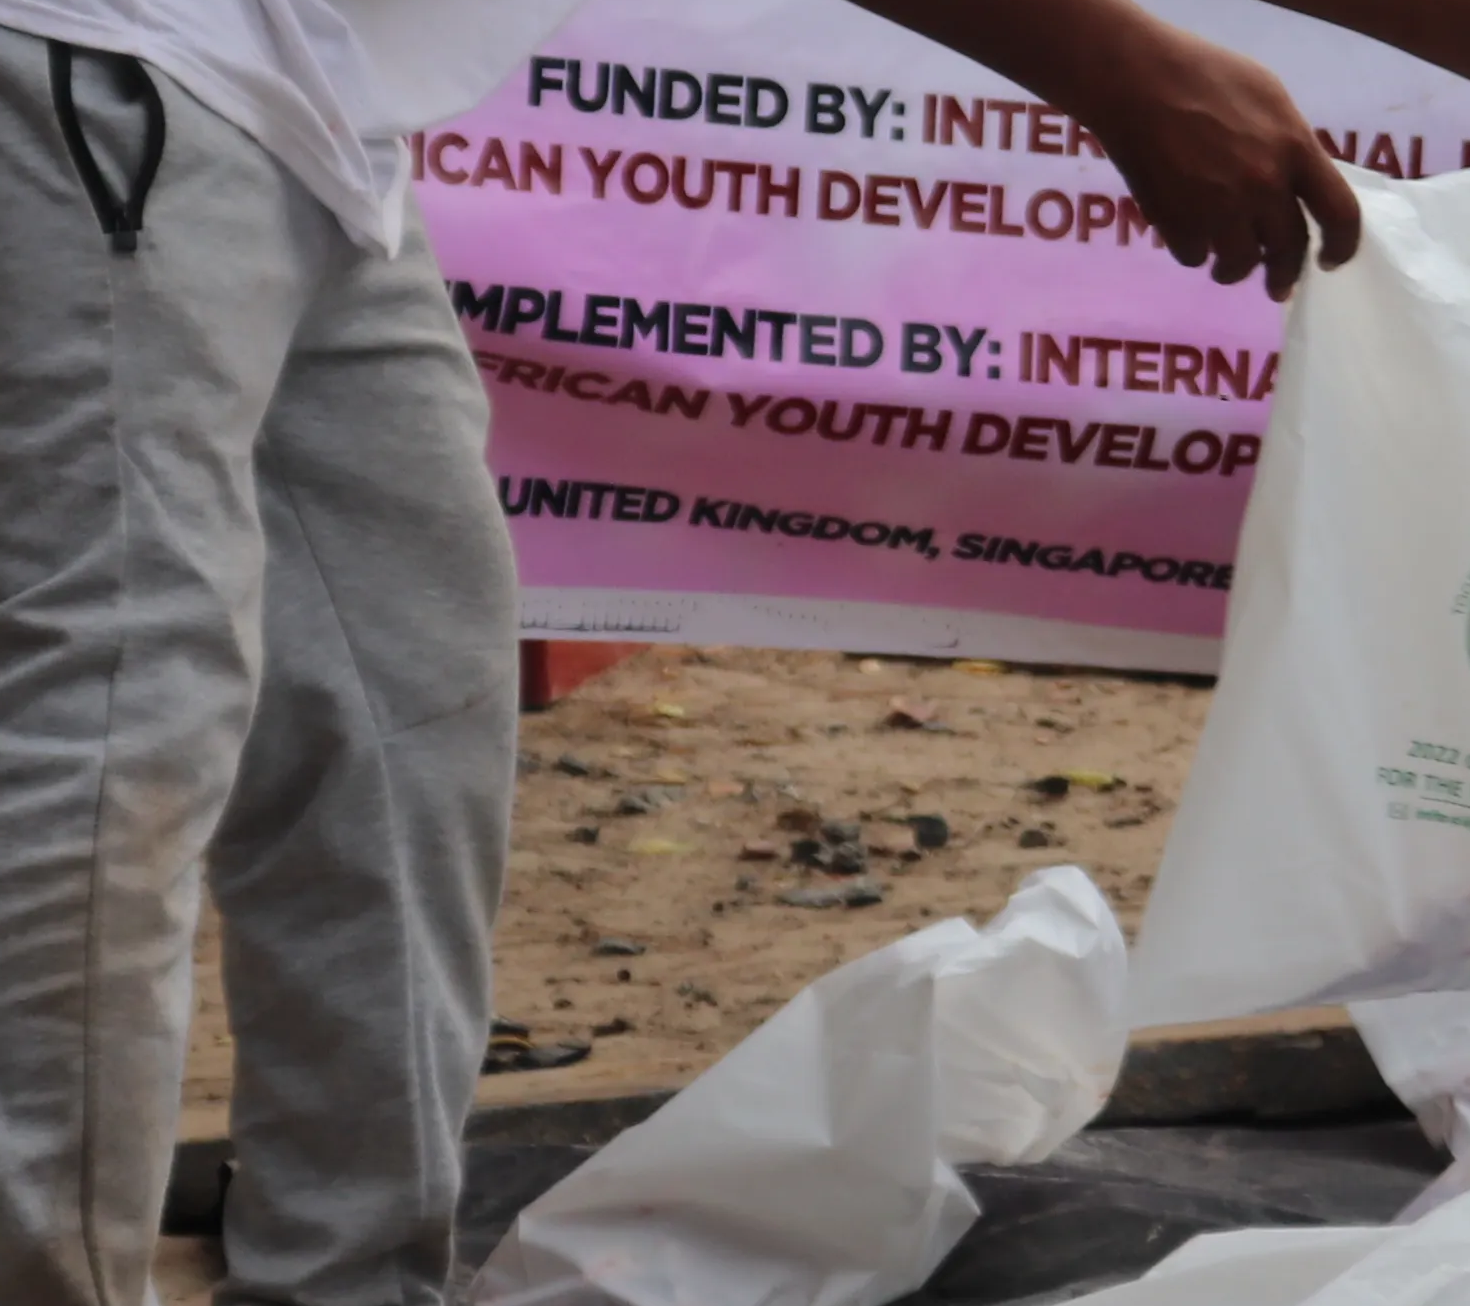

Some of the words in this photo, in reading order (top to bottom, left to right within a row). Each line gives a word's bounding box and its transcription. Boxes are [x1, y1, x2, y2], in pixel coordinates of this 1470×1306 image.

[529, 55, 788, 129] FUNDED
[805, 84, 906, 142] BY:
[404, 131, 563, 195] ICAN
[578, 145, 802, 219] YOUTH
[444, 280, 883, 368] MPLEMENTED
[900, 323, 1003, 380] BY:
[728, 391, 951, 450] YOUTH
[499, 475, 680, 523] UNITED
[689, 501, 940, 560] KINGDOM,
